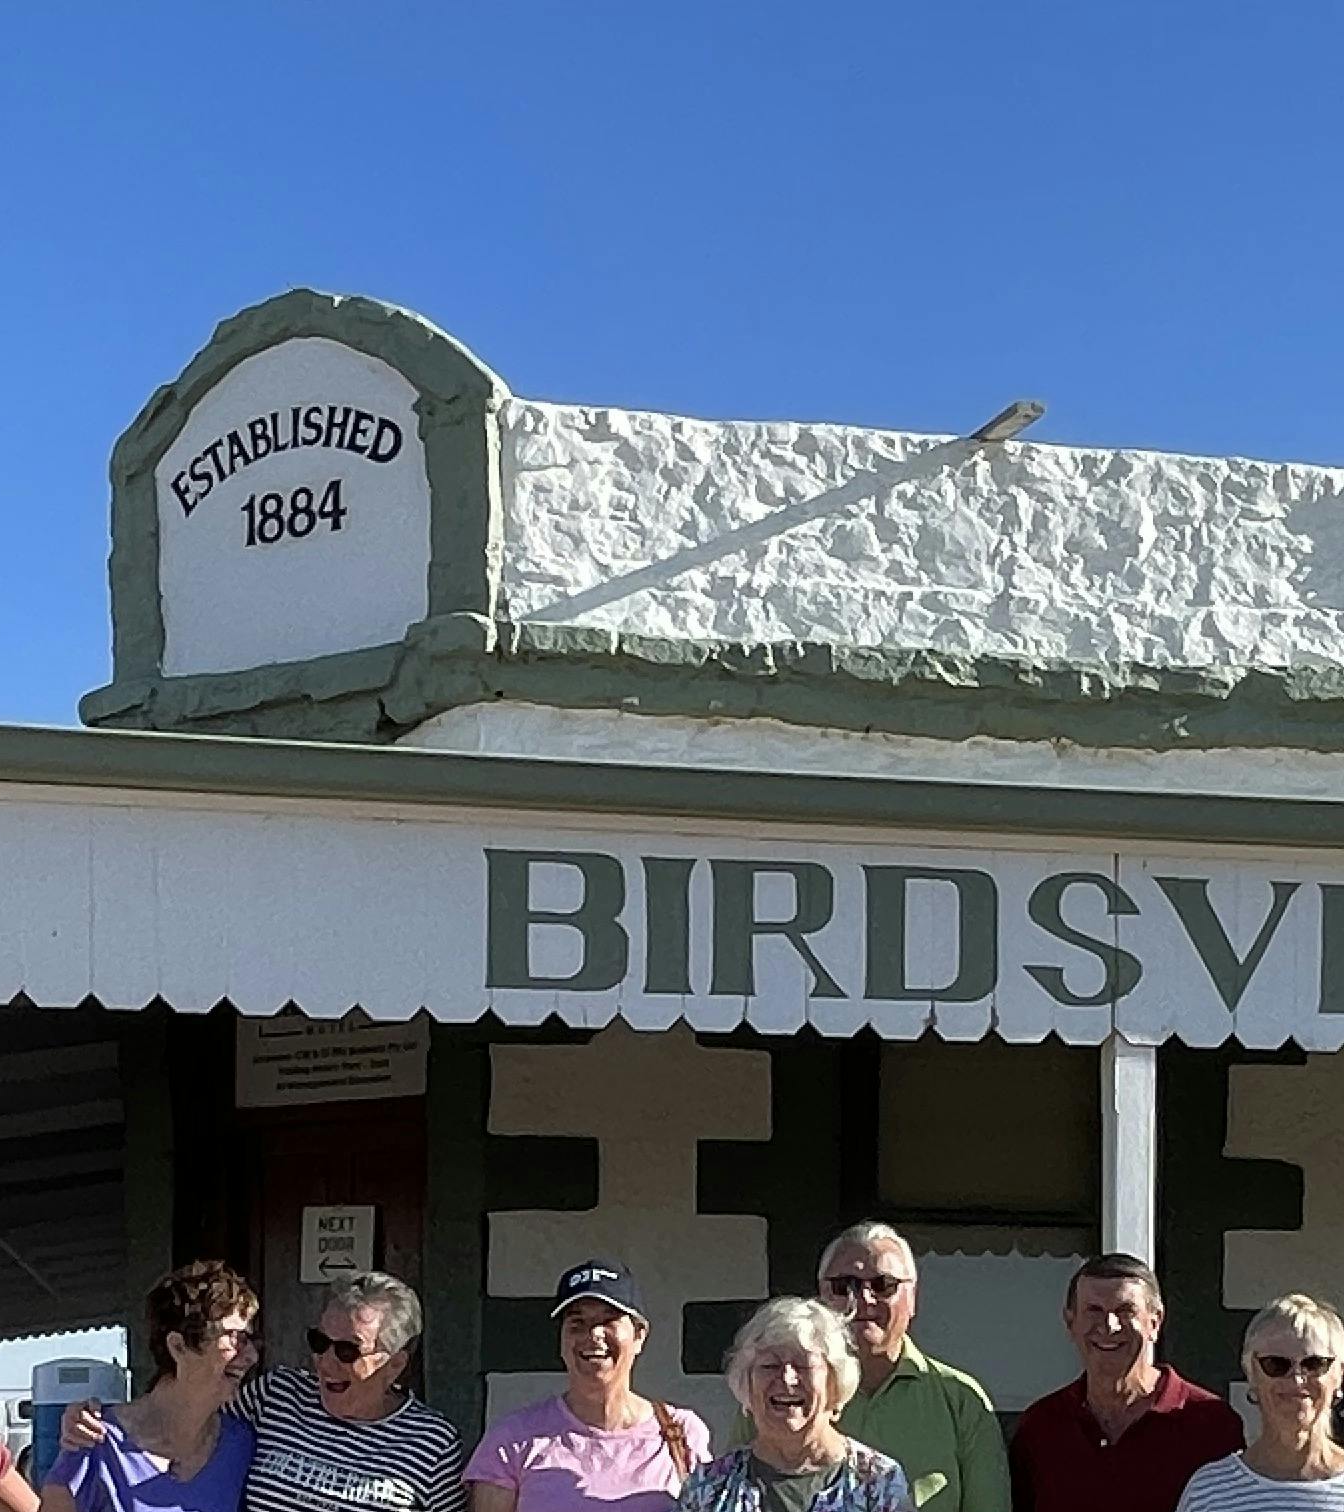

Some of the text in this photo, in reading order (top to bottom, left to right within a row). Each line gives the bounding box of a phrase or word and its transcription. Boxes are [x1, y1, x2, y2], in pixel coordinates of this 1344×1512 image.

[170, 405, 403, 517] ESTABLISHED
[241, 479, 347, 547] 1884
[318, 1216, 355, 1232] NEXT
